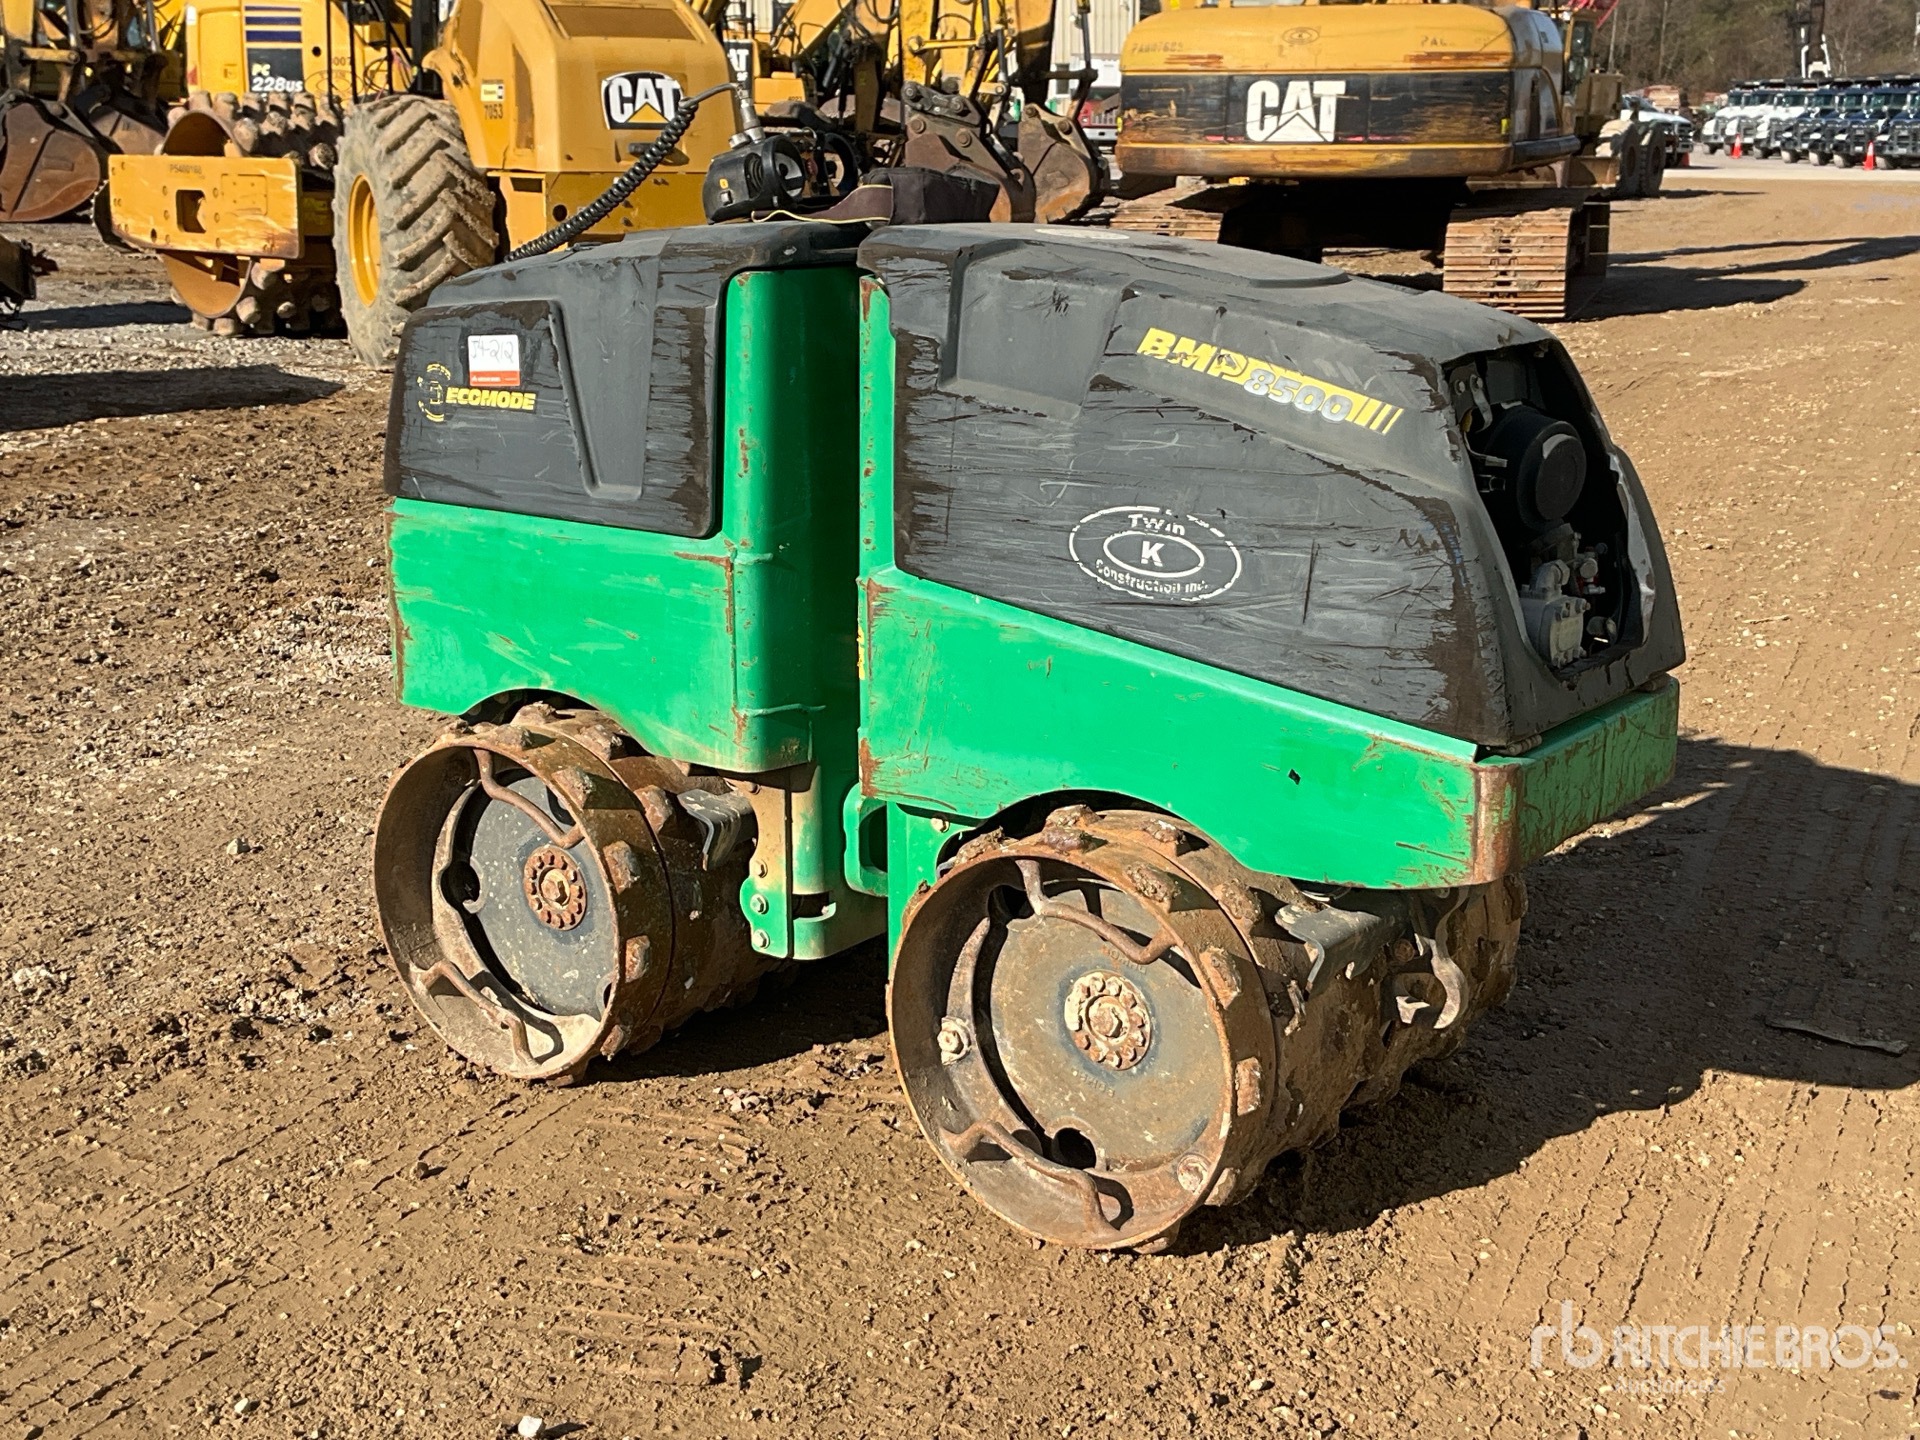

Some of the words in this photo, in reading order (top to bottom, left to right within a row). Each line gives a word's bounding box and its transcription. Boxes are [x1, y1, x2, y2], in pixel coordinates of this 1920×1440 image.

[252, 63, 271, 76] PC
[609, 78, 680, 124] CAT
[1246, 80, 1346, 142] CAT
[1137, 327, 1249, 379] BMP
[446, 386, 536, 411] ECOMODE
[1243, 368, 1353, 423] 8500
[1140, 541, 1165, 567] K
